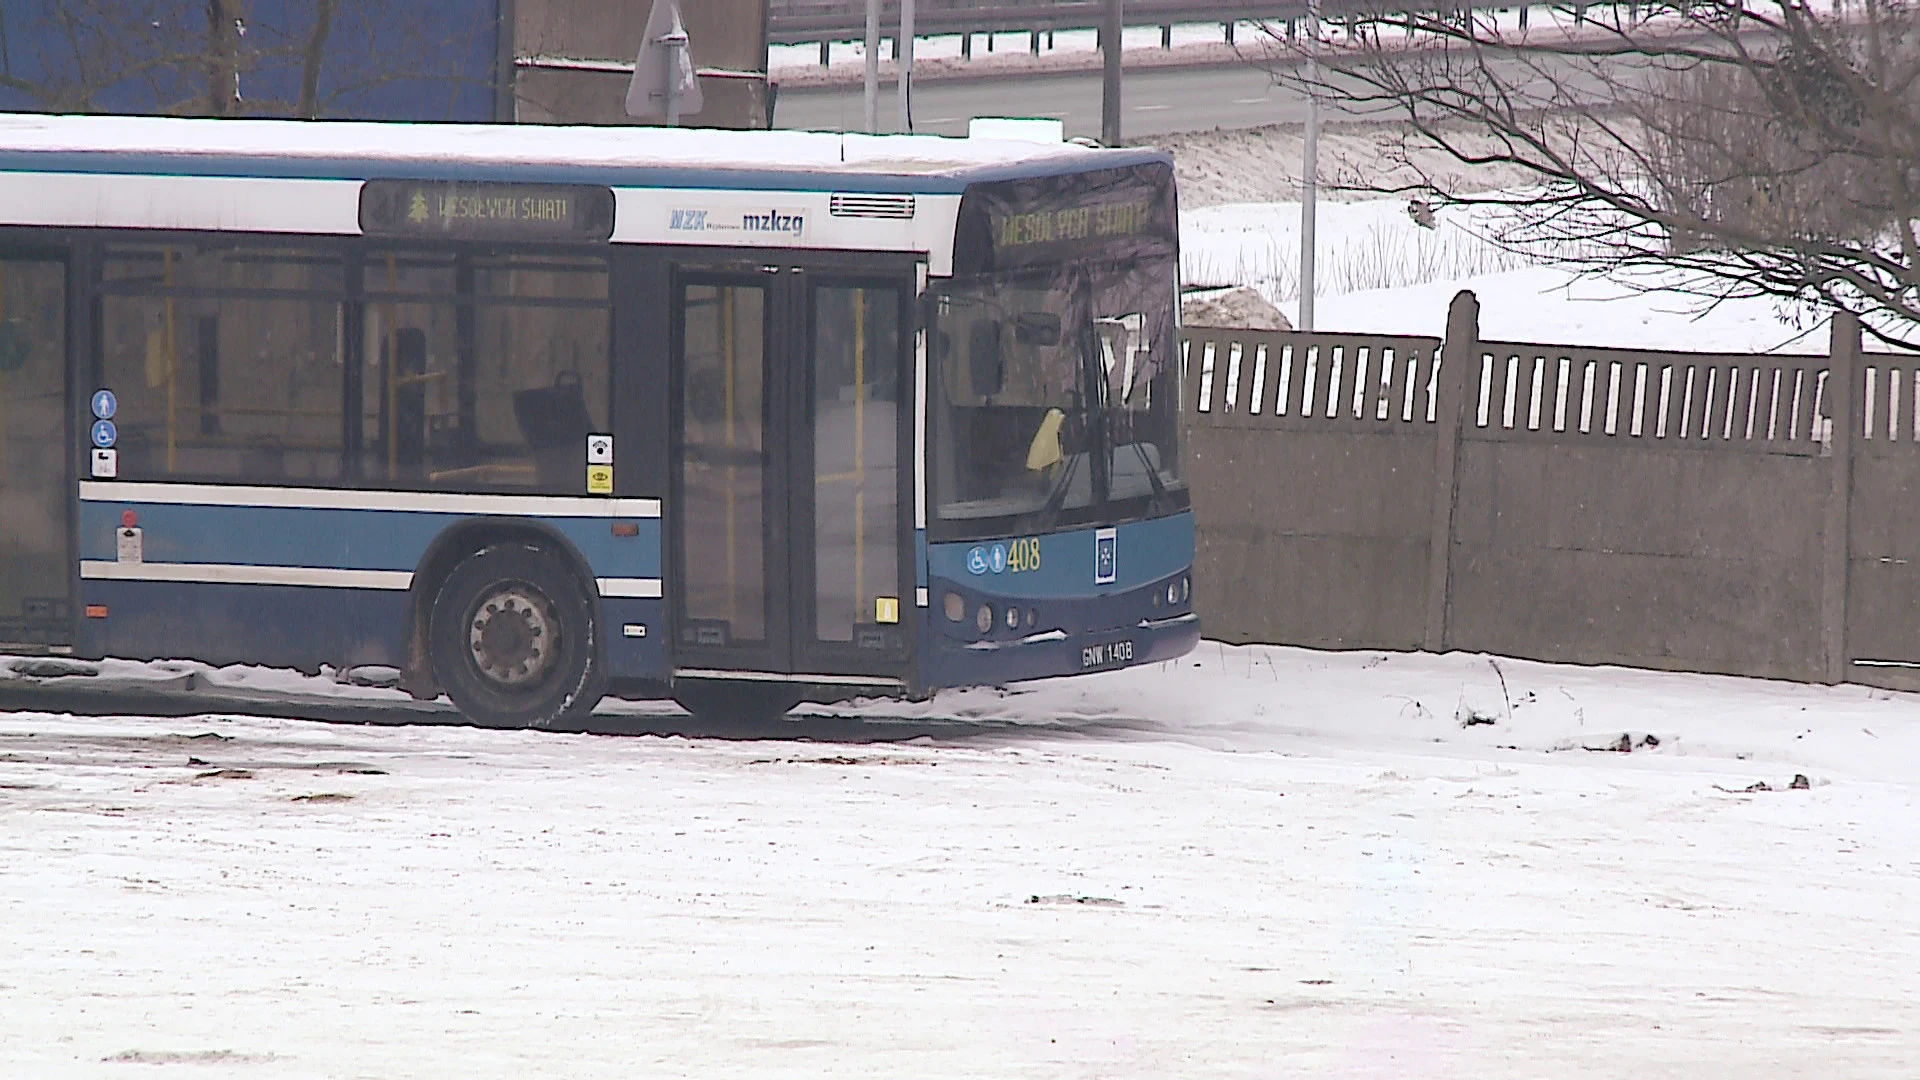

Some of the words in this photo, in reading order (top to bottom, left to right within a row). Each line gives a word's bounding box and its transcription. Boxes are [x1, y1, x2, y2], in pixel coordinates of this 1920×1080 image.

[743, 209, 803, 237] mzkzg
[1007, 537, 1041, 572] 408
[1082, 646, 1104, 667] GNW
